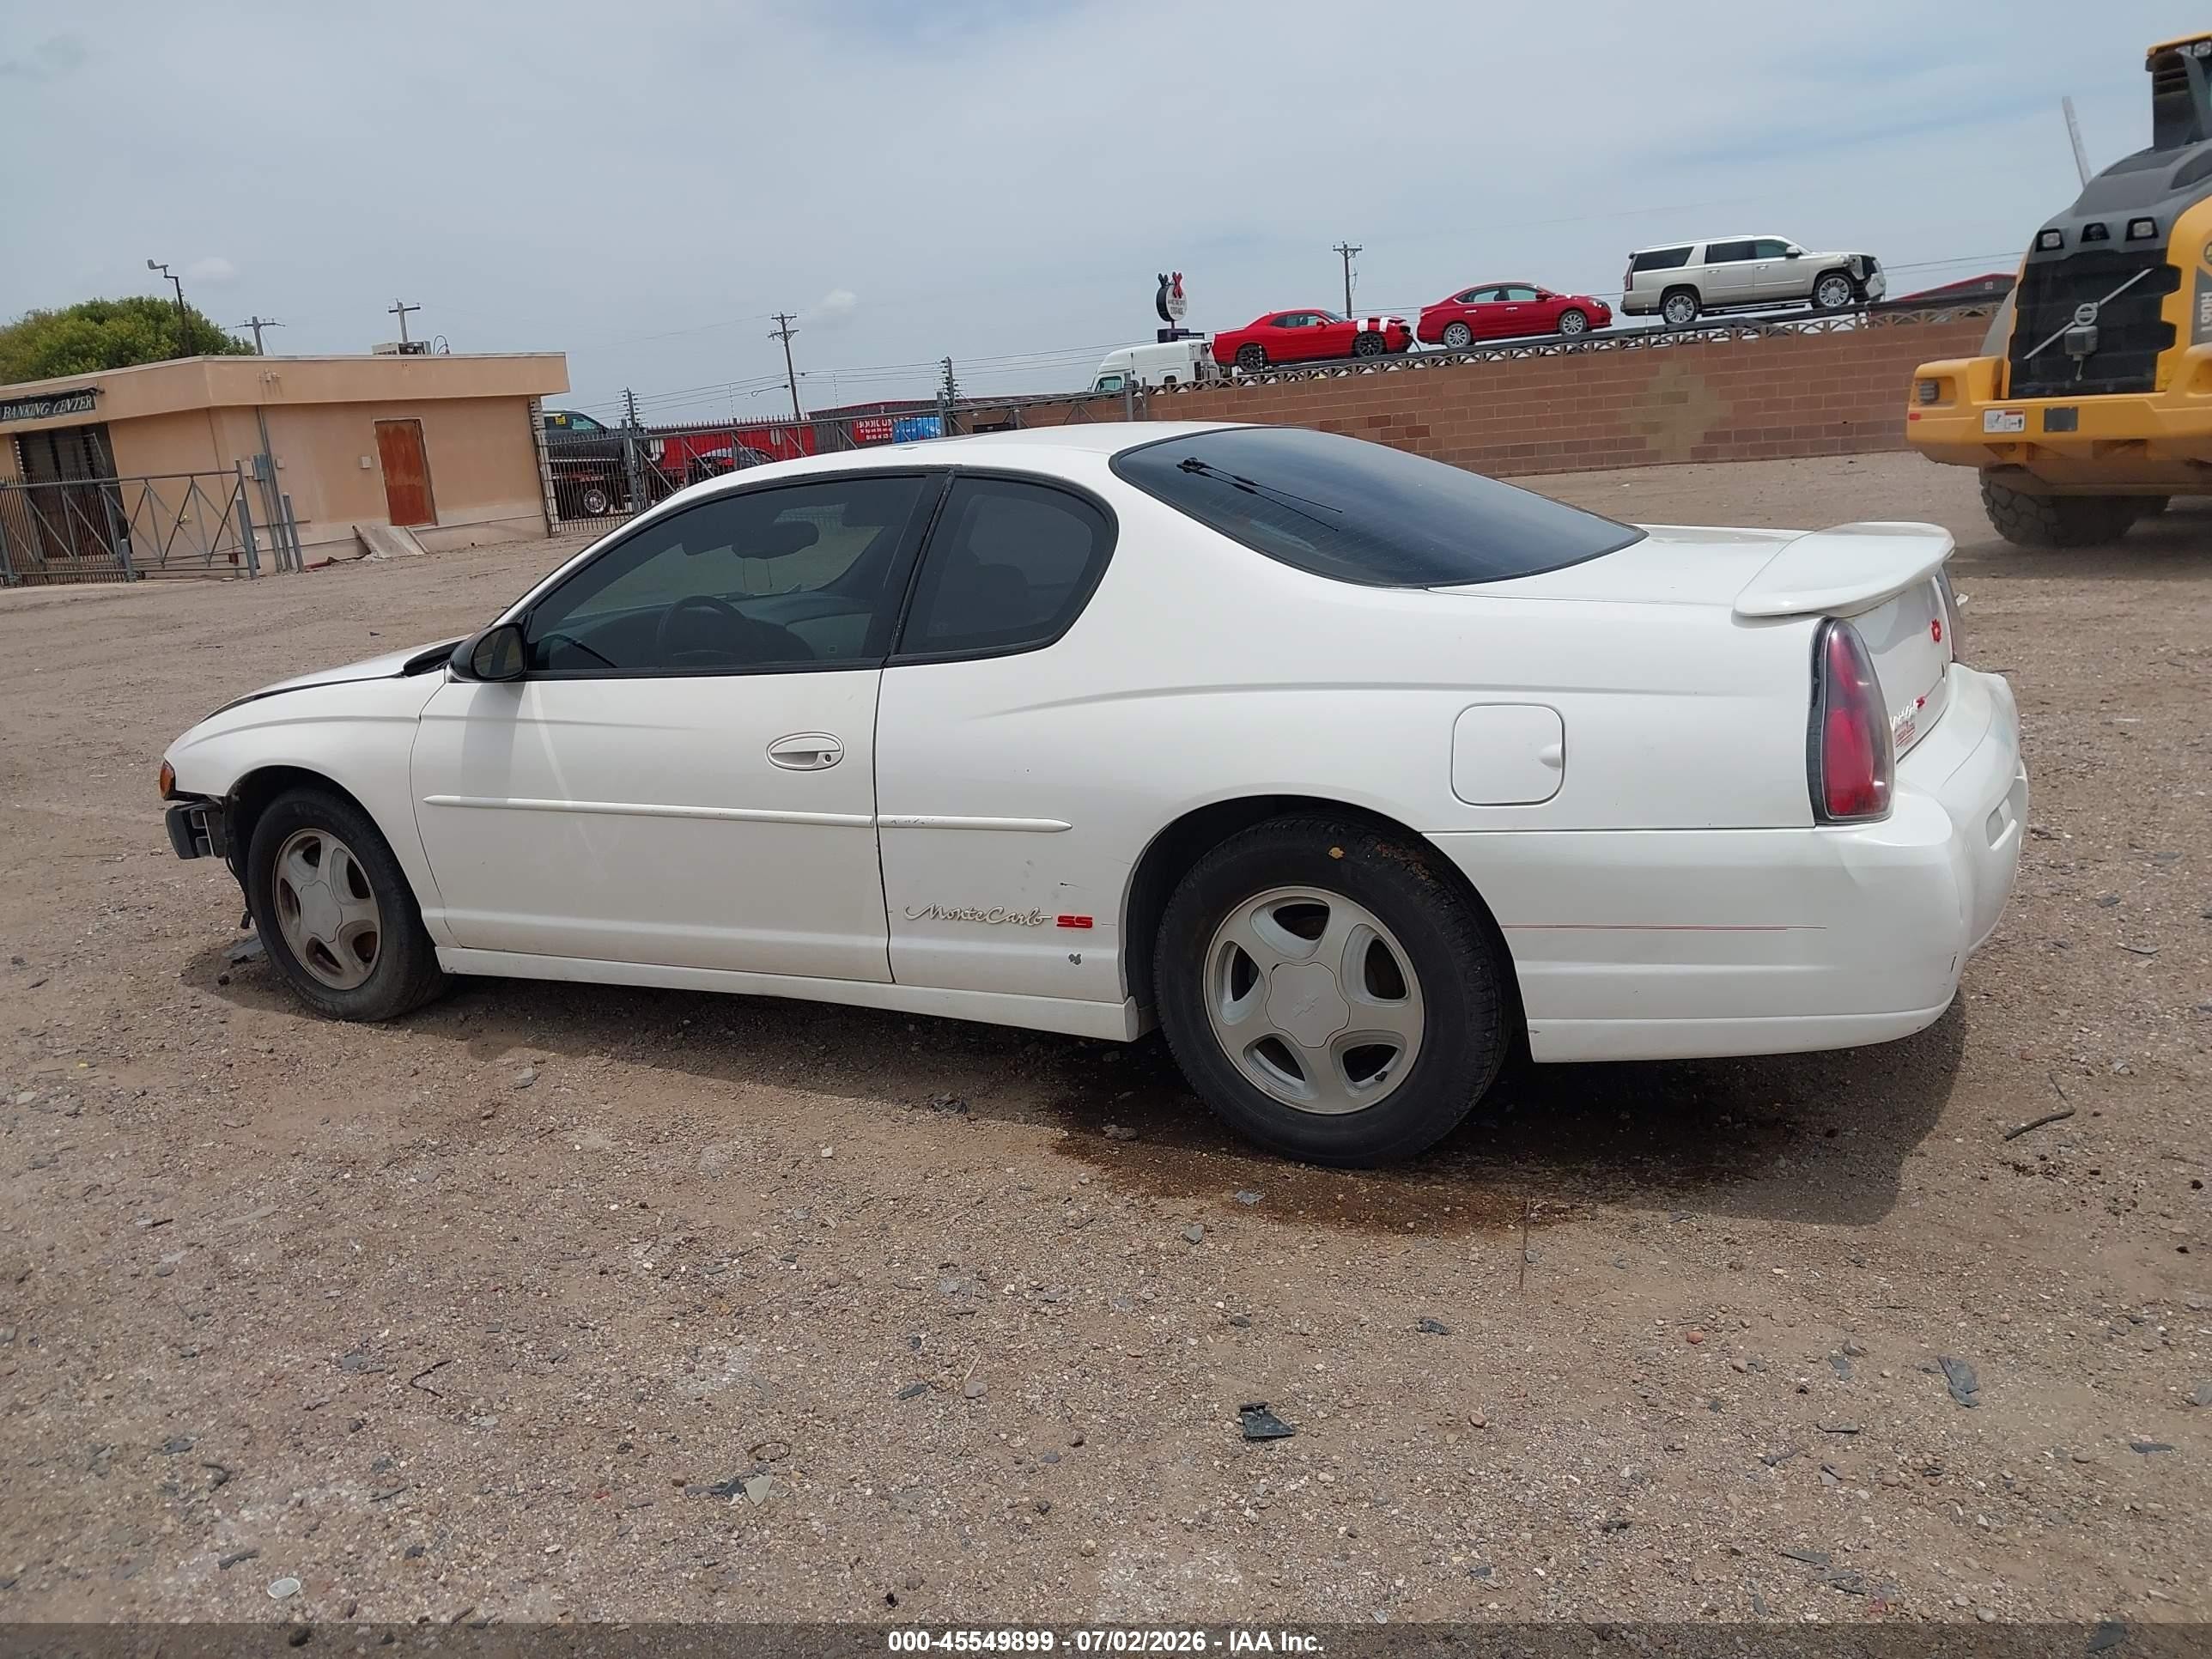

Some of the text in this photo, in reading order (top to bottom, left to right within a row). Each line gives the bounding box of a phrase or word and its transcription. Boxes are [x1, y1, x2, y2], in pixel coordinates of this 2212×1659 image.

[2, 394, 93, 420] BANKING CENTER
[1056, 915, 1093, 928] SS
